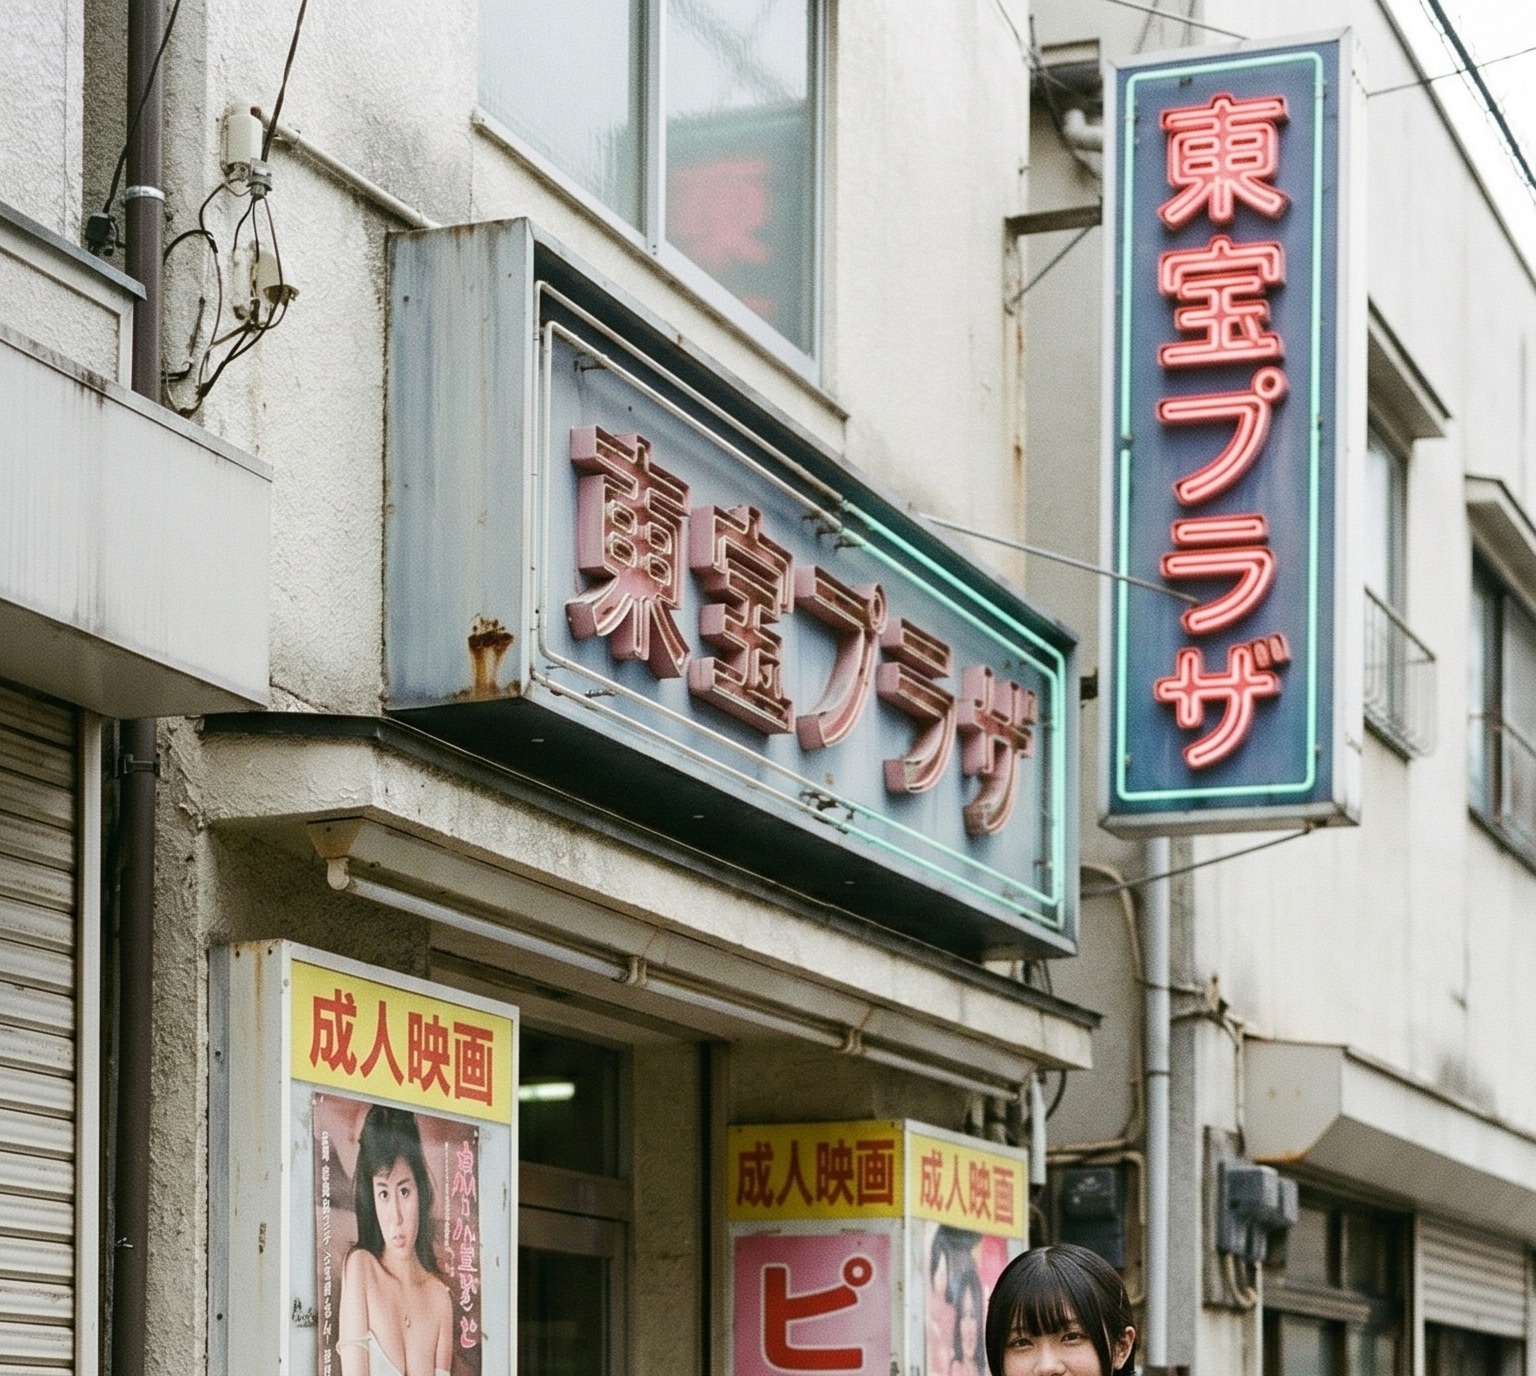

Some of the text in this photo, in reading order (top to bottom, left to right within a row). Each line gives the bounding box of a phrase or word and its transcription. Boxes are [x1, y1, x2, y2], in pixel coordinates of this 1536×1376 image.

[1154, 93, 1291, 770] 東宝プラザ
[565, 424, 1037, 836] 東宝プラザ
[309, 987, 494, 1107] 成人映画
[736, 1138, 895, 1208] 成人映画
[920, 1148, 1015, 1226] 成人映画
